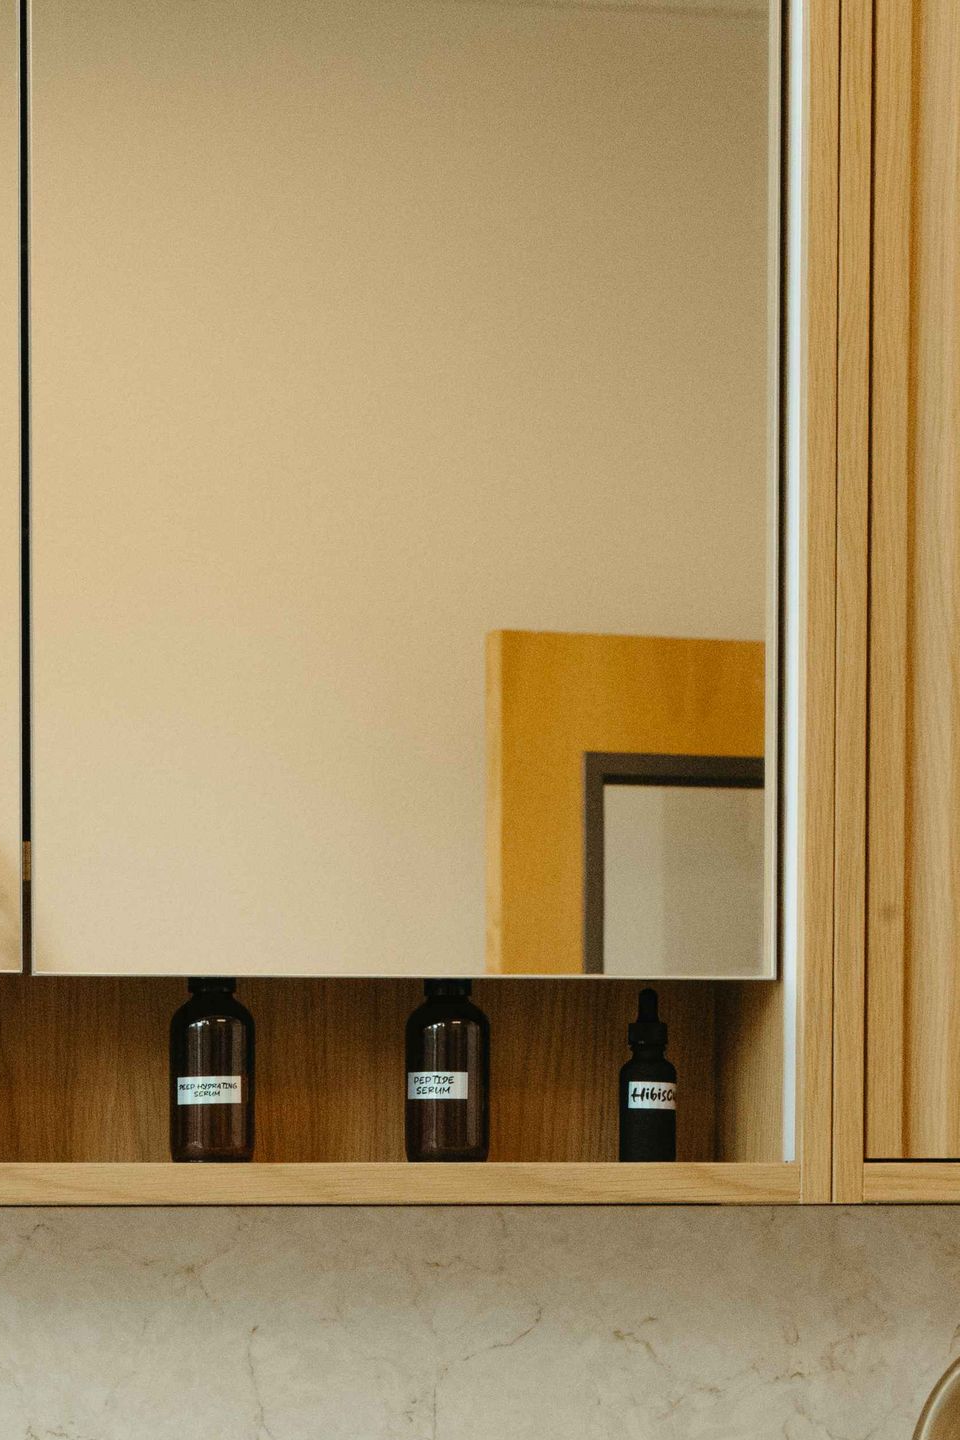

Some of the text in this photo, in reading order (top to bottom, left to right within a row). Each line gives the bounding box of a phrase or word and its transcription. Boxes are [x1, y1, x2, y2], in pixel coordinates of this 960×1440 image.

[413, 1075, 455, 1085] PEPTIDE
[196, 1082, 238, 1090] HYDRATING
[416, 1086, 451, 1095] SERUM
[193, 1090, 221, 1098] SERUM
[630, 1087, 676, 1102] Hibisc
